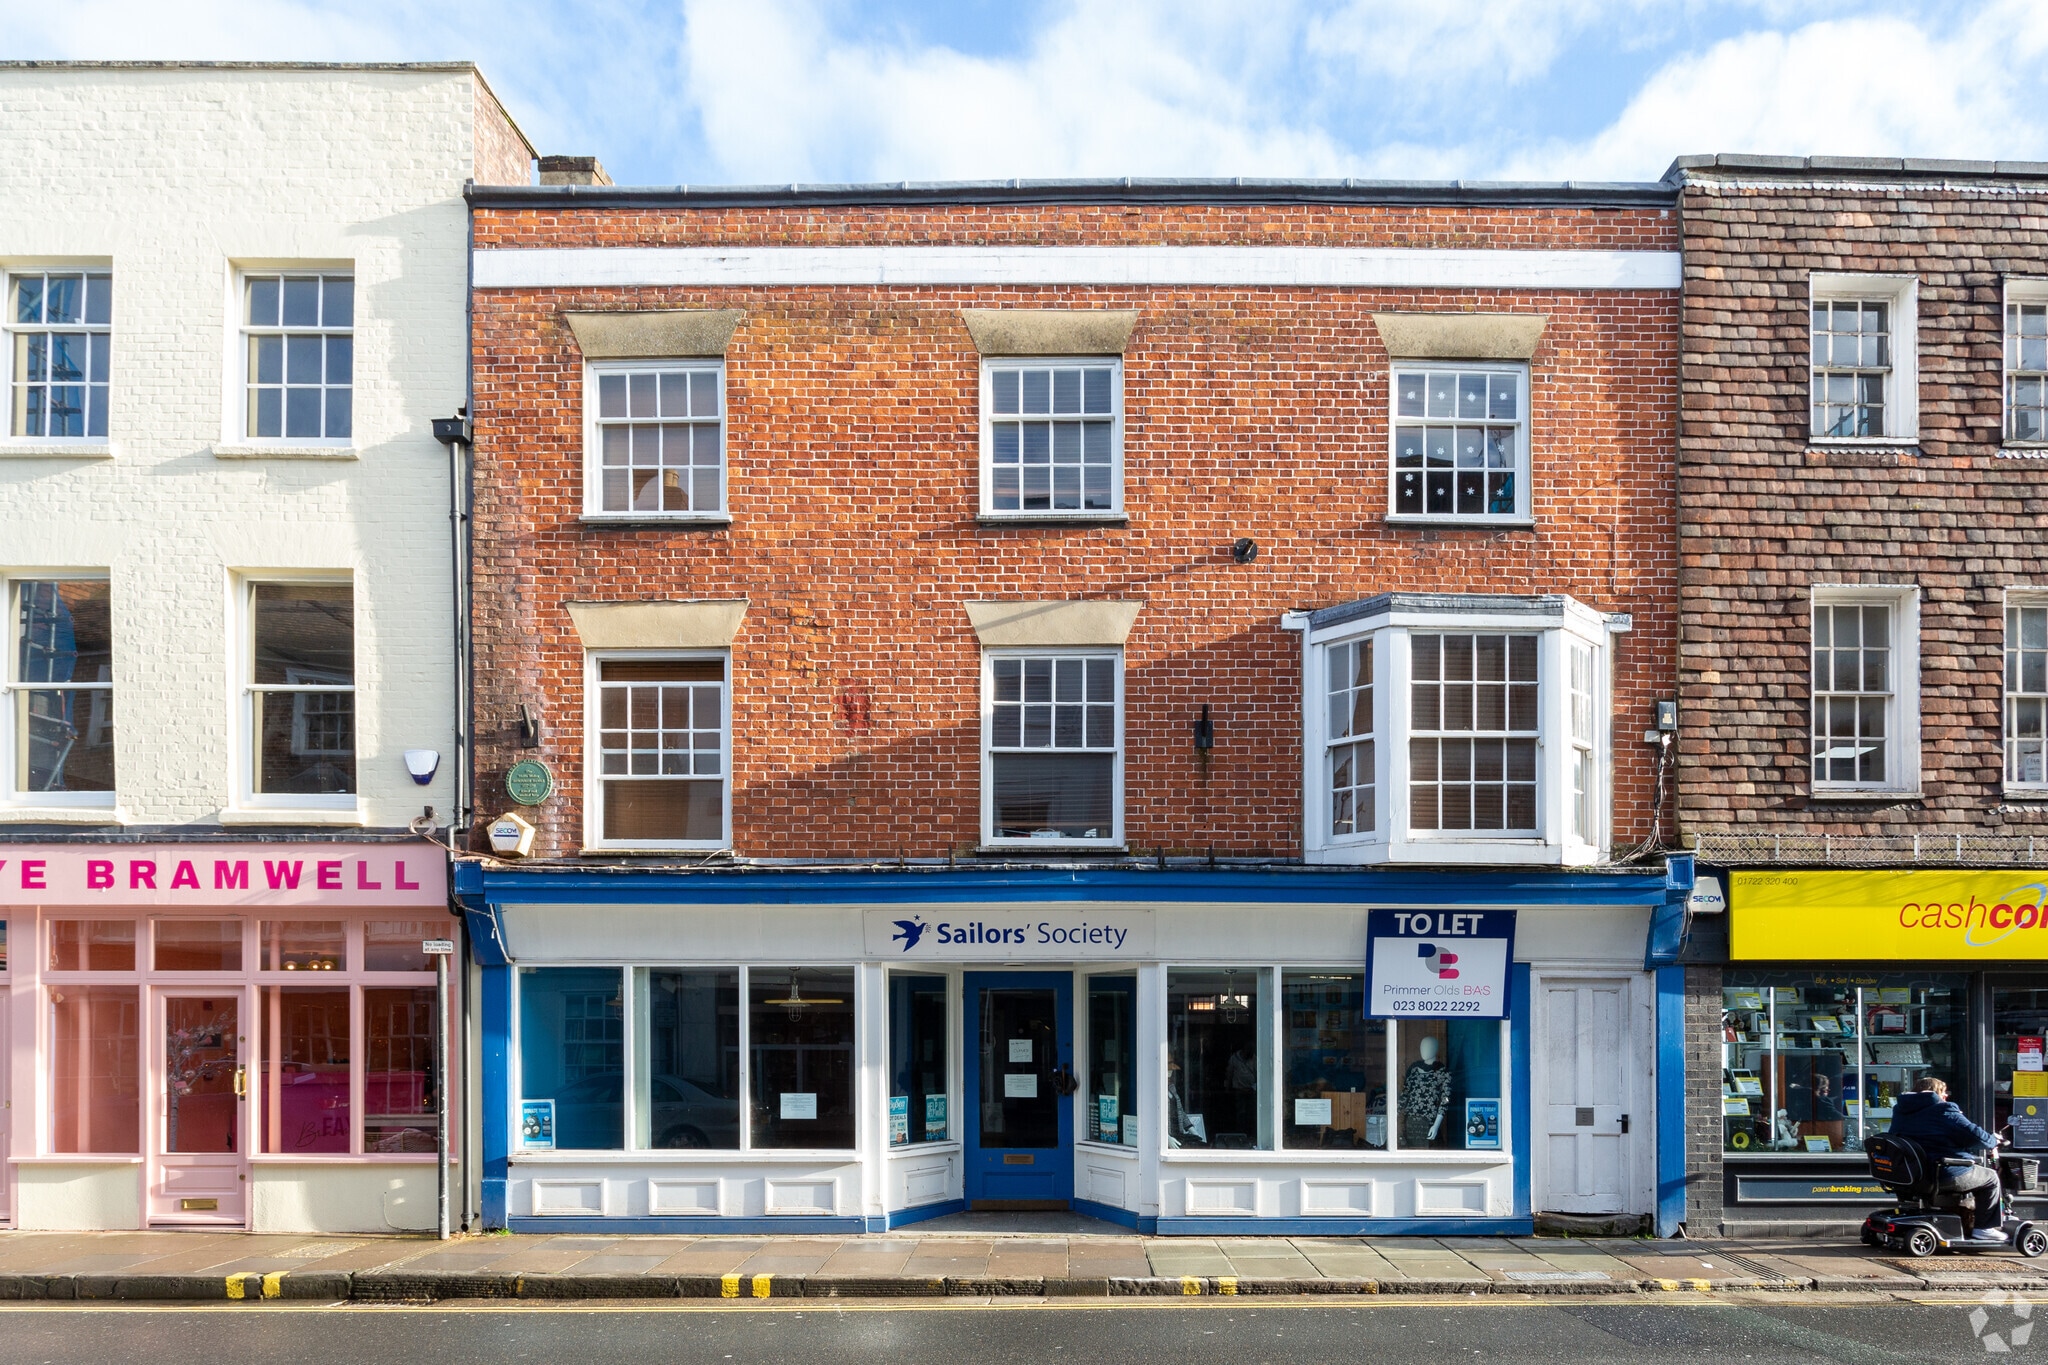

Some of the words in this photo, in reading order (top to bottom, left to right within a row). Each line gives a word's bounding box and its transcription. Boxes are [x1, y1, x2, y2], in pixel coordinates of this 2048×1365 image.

[0, 860, 47, 889] E
[87, 860, 420, 890] BRAMWELL
[1737, 877, 1762, 886] 01722
[1764, 877, 1780, 886] 320
[1782, 877, 1798, 886] 400
[1692, 895, 1721, 903] SECOM
[1394, 913, 1432, 935] TO
[1437, 913, 1484, 935] LET
[937, 922, 1031, 944] Sailors'
[1037, 922, 1128, 950] Society
[1815, 977, 1828, 985] Buy
[1383, 984, 1431, 995] Primmer
[1433, 984, 1460, 995] Olds
[1393, 1000, 1416, 1011] 023
[1418, 1000, 1448, 1012] 8022
[1450, 1001, 1480, 1012] 2292
[1812, 1185, 1861, 1194] pawnbroking
